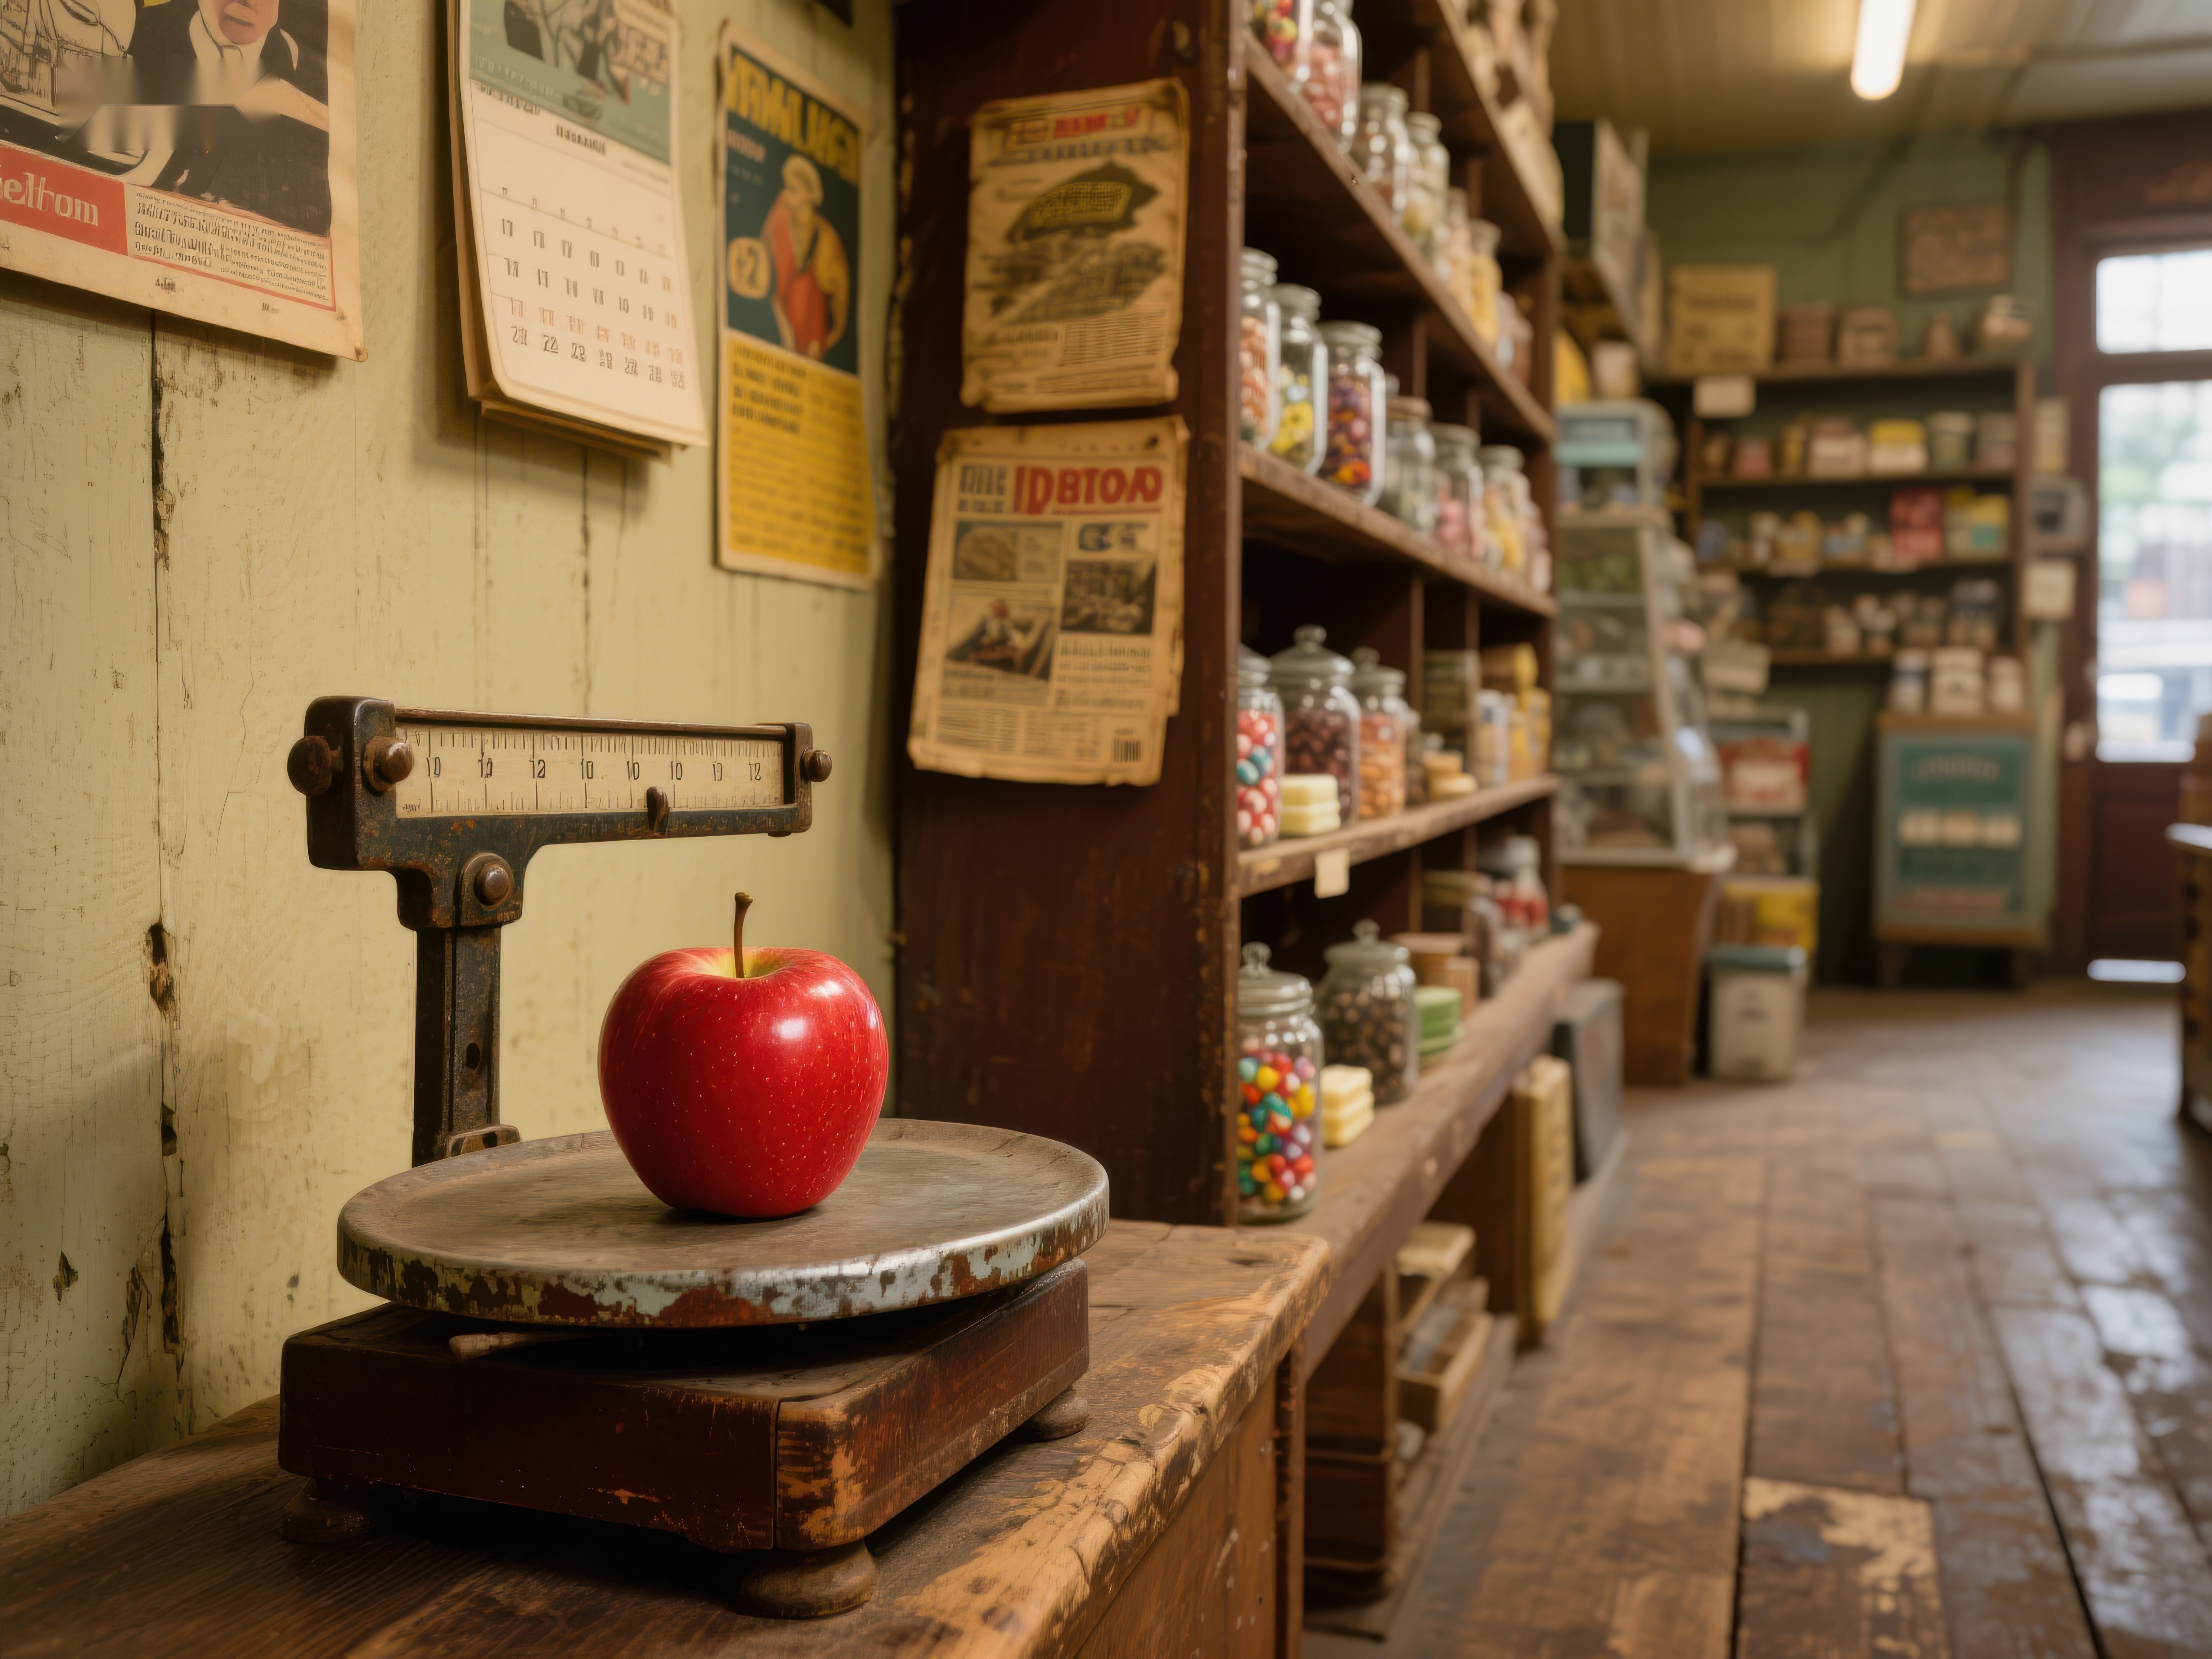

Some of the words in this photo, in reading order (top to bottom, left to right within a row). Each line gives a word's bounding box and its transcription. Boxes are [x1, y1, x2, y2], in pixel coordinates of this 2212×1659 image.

[580, 758, 593, 779] 10
[627, 760, 639, 781] 10
[671, 761, 683, 780] 10
